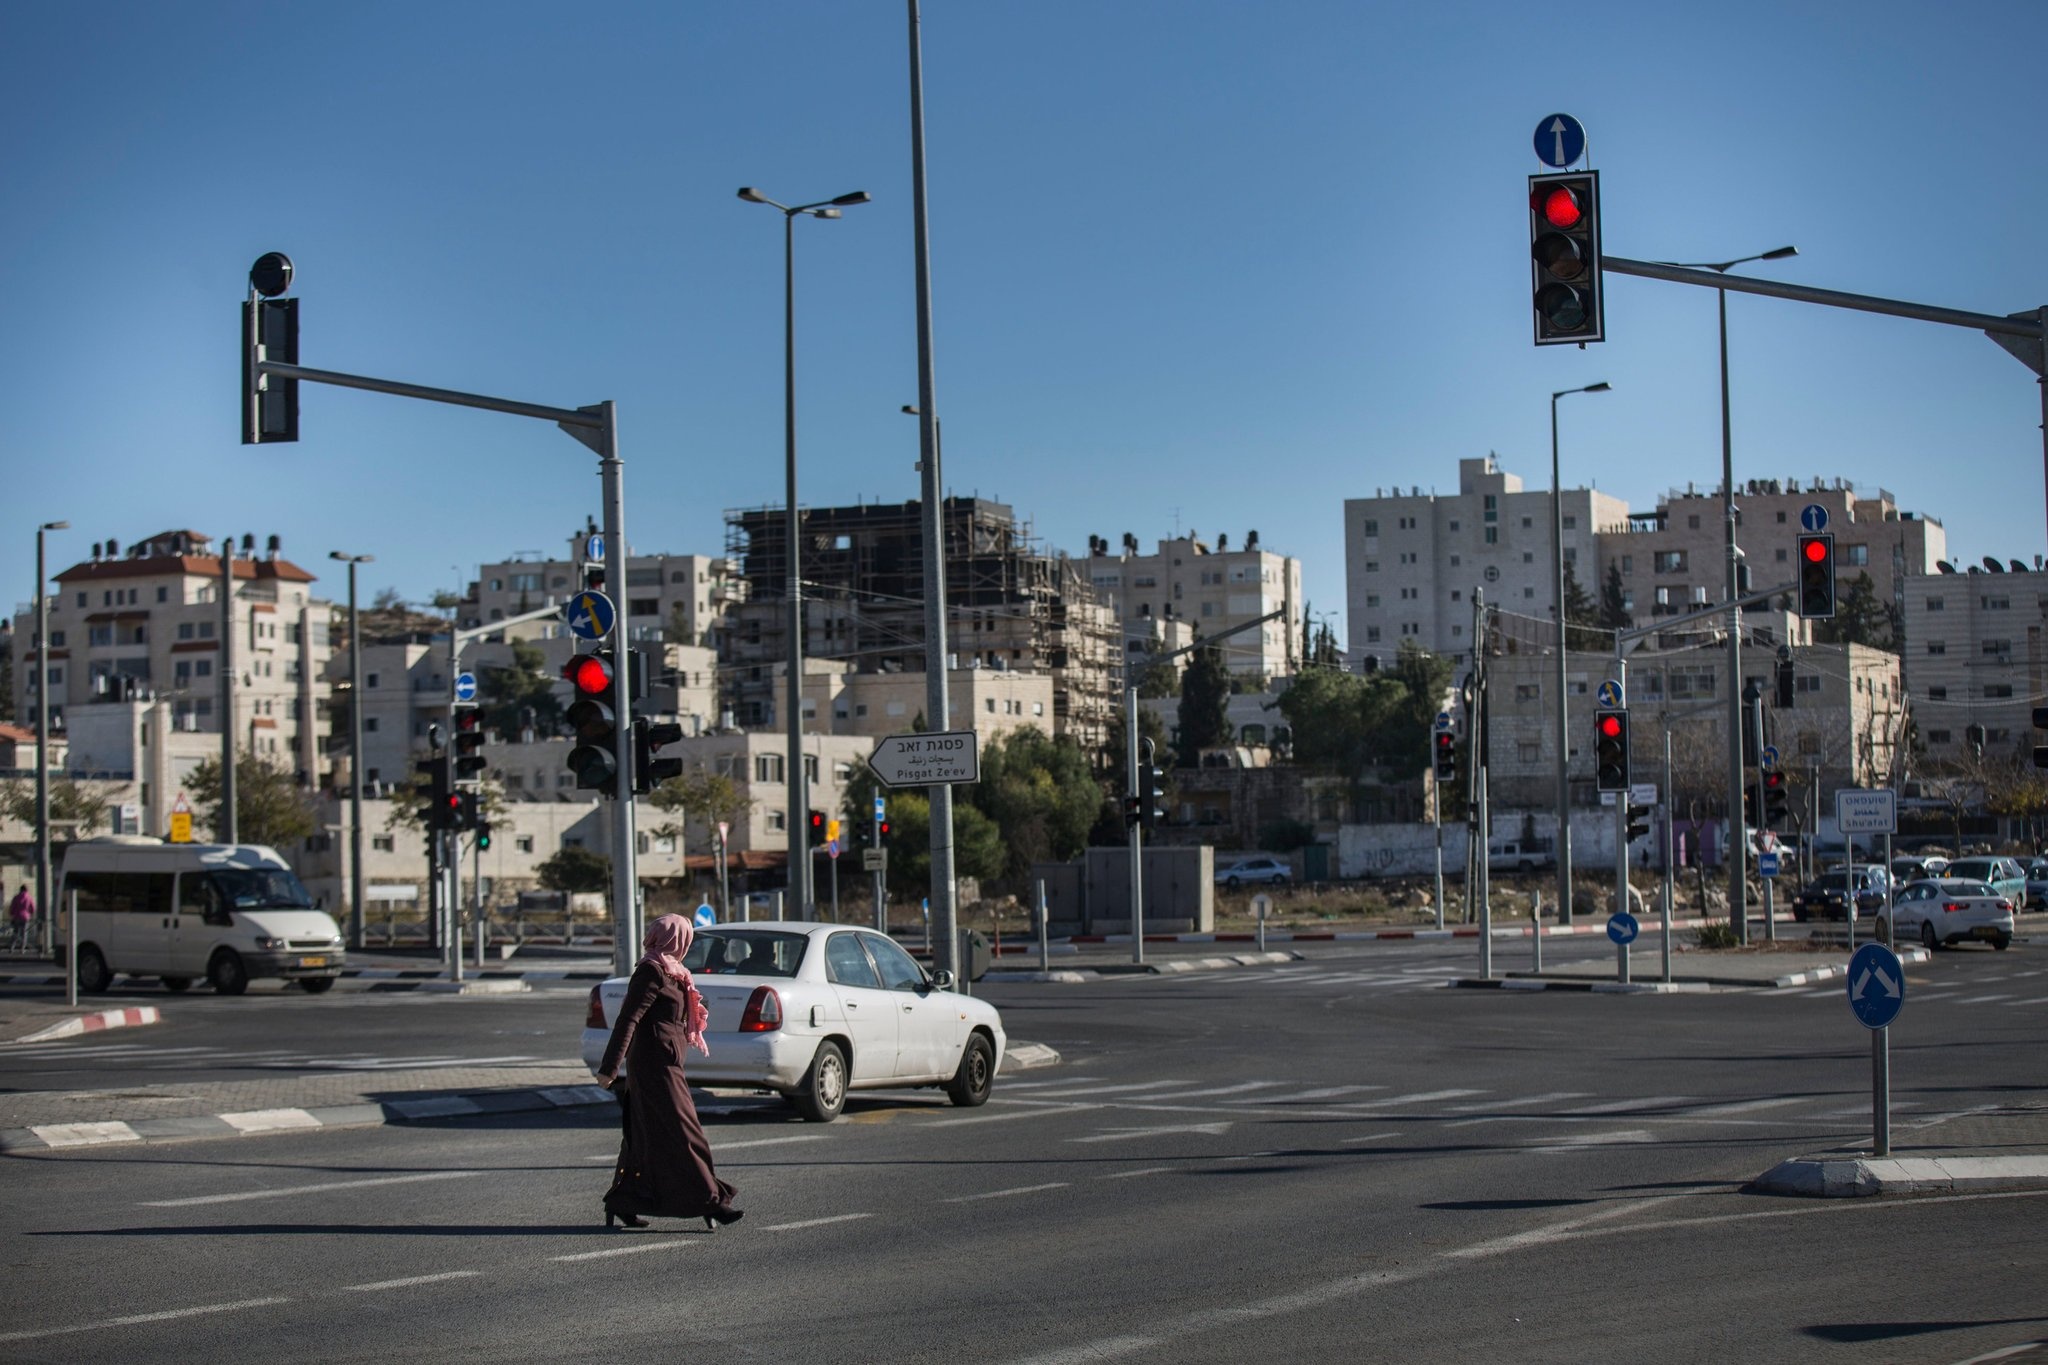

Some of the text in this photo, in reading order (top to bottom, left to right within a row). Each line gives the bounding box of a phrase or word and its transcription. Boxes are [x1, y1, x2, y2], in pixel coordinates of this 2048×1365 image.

[897, 739, 964, 753] פסגת זאב
[897, 767, 966, 780] Pisgat Ze'ev
